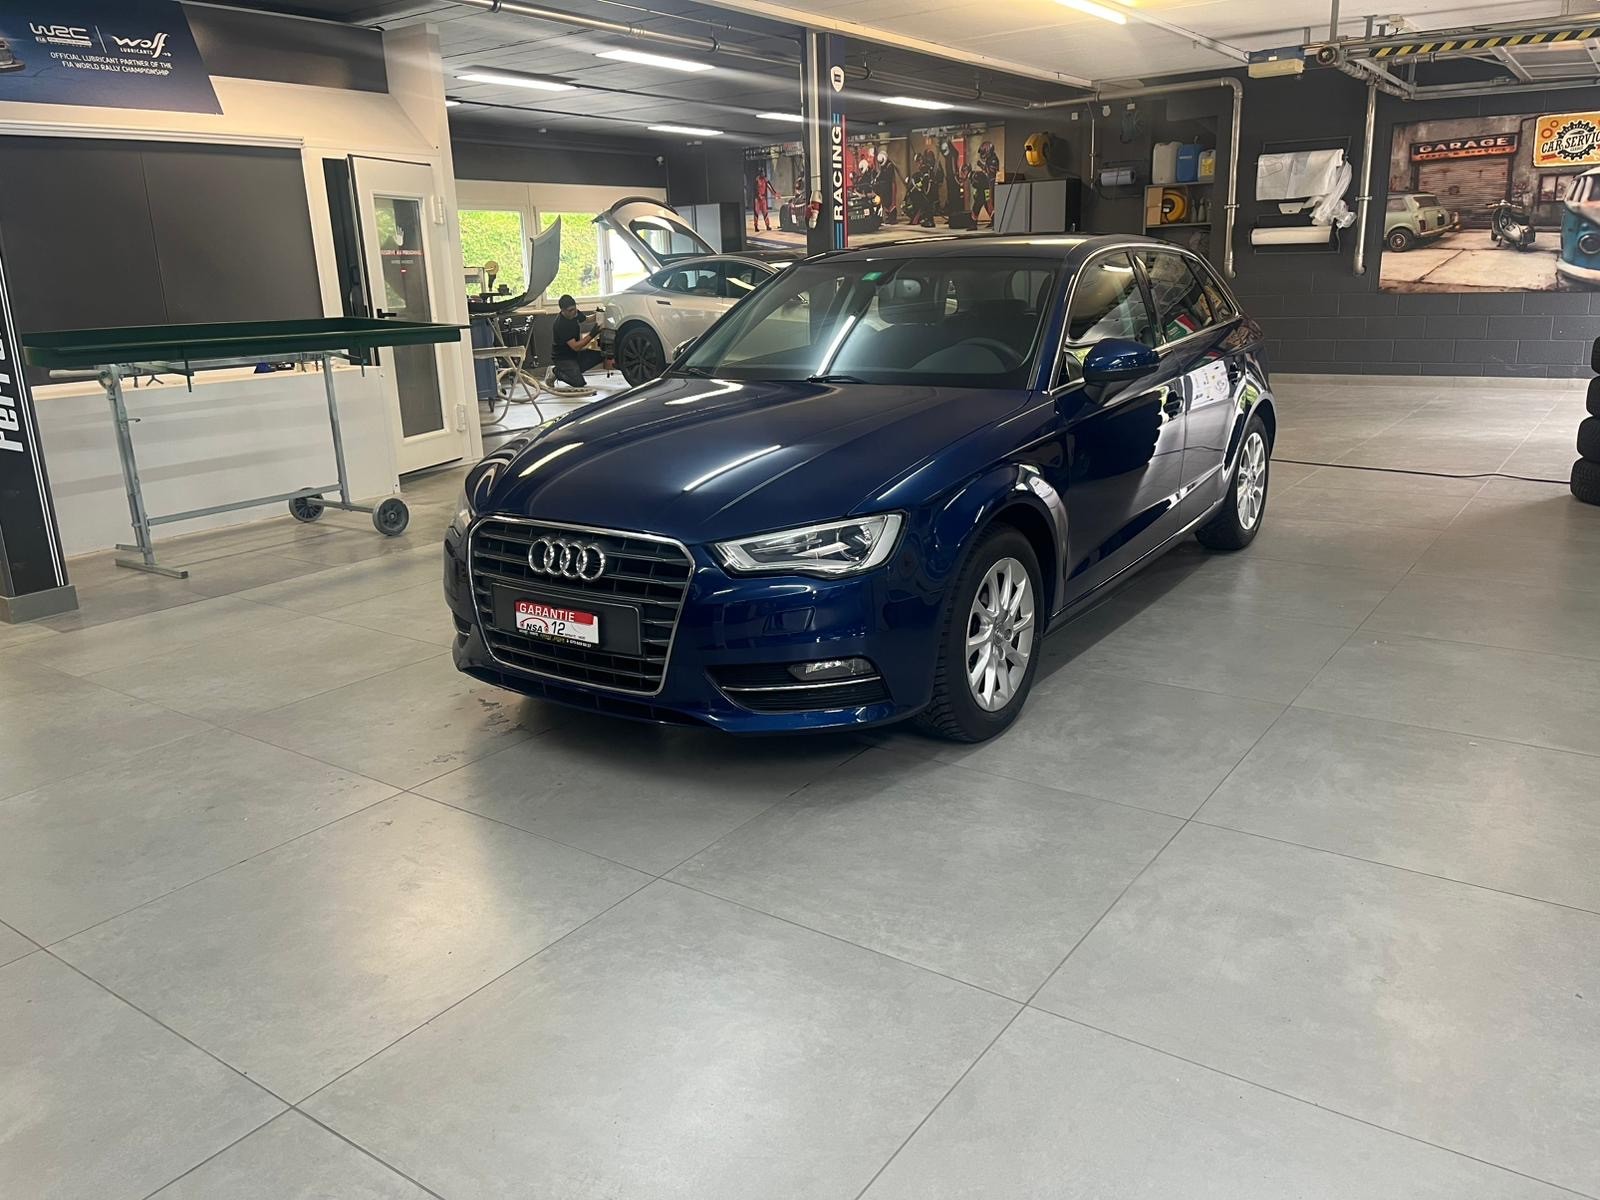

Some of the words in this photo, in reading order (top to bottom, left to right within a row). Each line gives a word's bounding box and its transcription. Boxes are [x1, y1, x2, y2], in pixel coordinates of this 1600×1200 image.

[29, 22, 90, 39] WRC
[50, 51, 81, 60] OFFICIAL
[81, 54, 119, 64] LUBRICANT
[120, 58, 149, 67] PARTNER
[62, 60, 74, 68] FIA
[74, 62, 99, 70] WORLD
[100, 64, 120, 72] RALLY
[121, 65, 170, 75] CHAMPIONSHIP
[1419, 137, 1510, 153] GARAGE
[1541, 139, 1563, 154] CAR
[832, 126, 844, 221] RACING
[519, 603, 576, 622] GARANTIE
[526, 623, 543, 633] NSA
[551, 621, 566, 636] 12
